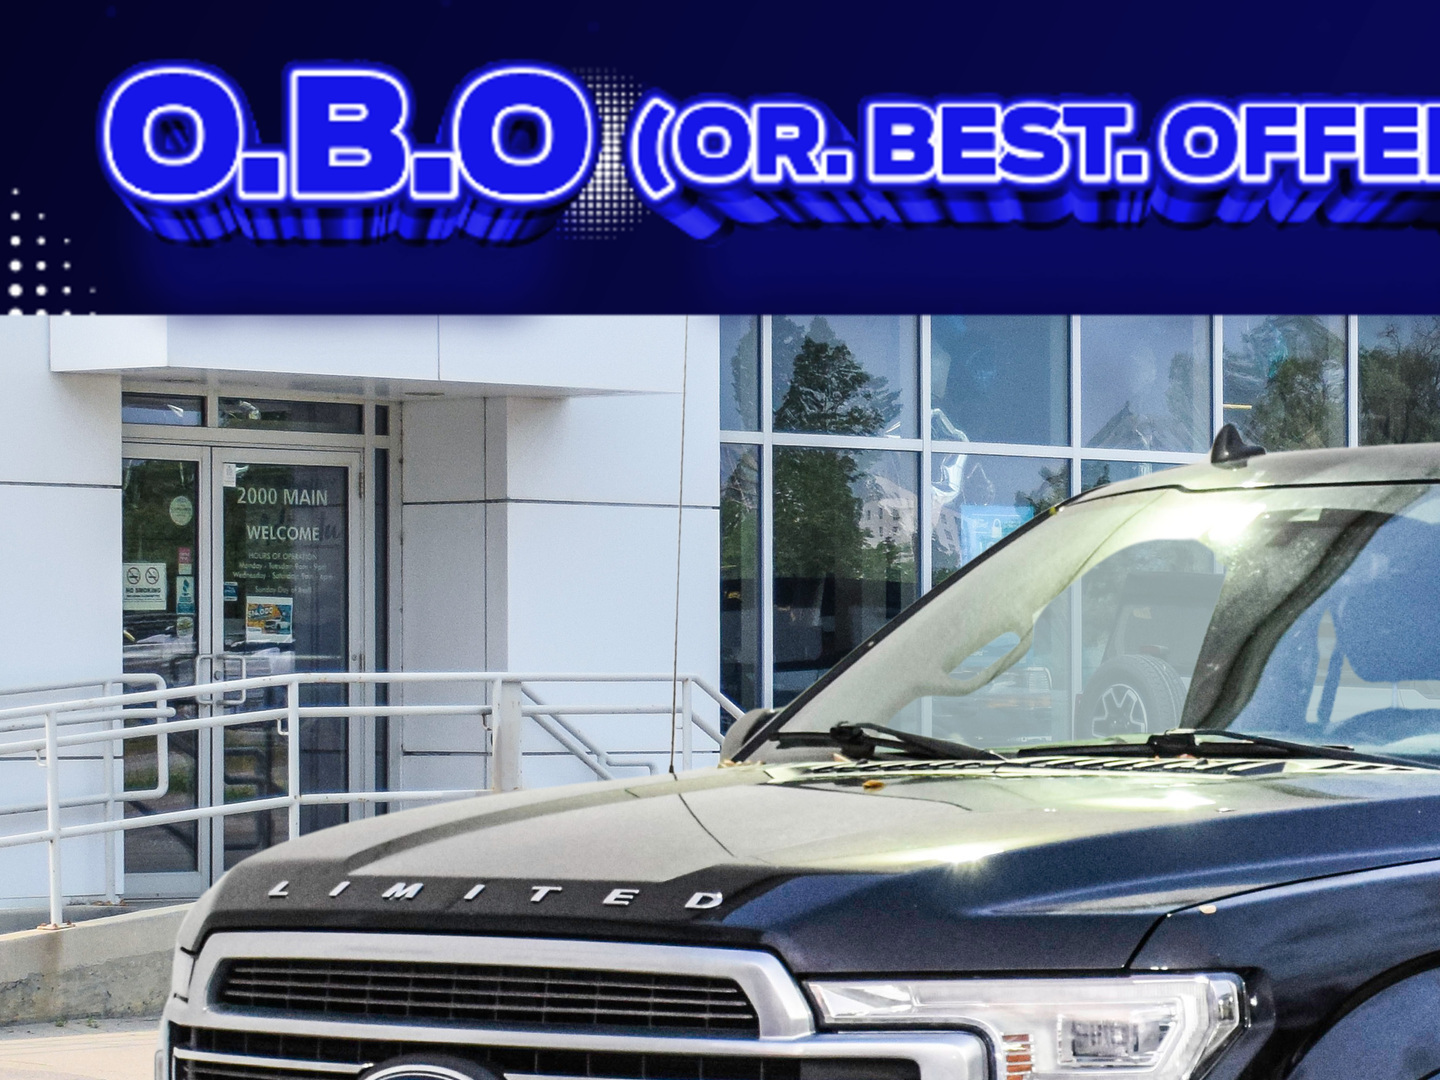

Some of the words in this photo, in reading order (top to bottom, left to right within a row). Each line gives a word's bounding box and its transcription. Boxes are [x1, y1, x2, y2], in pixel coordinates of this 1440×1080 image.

[237, 487, 278, 505] 2000
[283, 489, 328, 506] MAIN
[246, 525, 320, 541] WELCOME
[248, 552, 271, 560] HOURS
[268, 881, 724, 910] LIMITED
